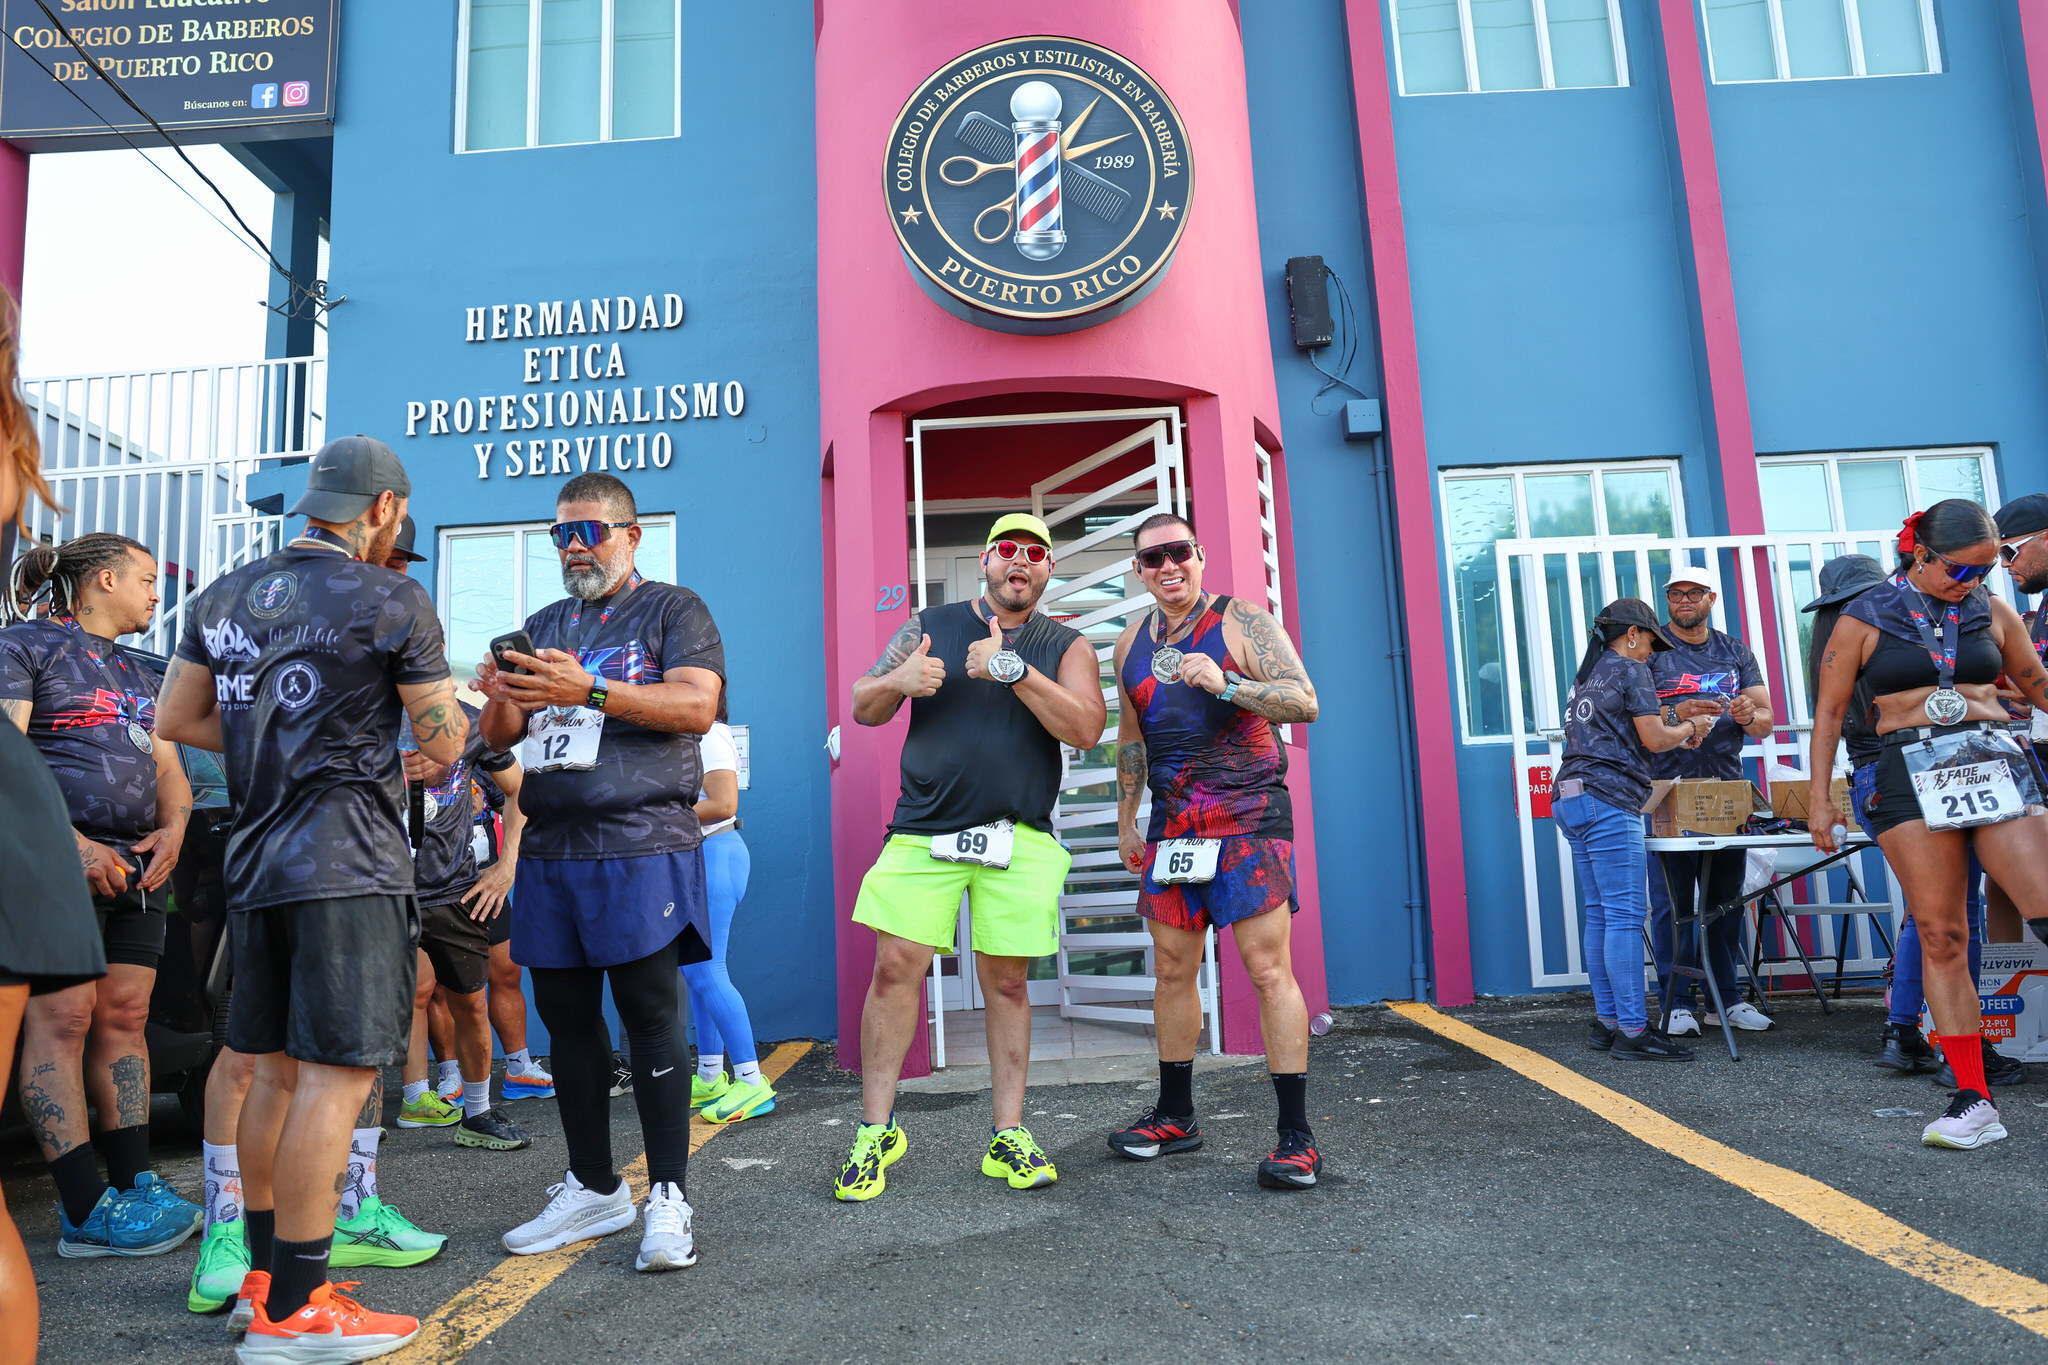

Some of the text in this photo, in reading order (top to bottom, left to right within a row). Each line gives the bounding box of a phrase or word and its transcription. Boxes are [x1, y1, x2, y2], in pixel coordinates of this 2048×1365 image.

[14, 16, 314, 50] COLEGIO DE BARBEROS
[53, 51, 274, 82] DE PUERTO RICO
[184, 98, 248, 110] Búscanos en:
[897, 50, 1181, 192] COLEGIO DE BARBEROS Y ESTILISTAS EN BARBERÍA
[1093, 155, 1135, 170] 1989
[938, 254, 1142, 305] PUERTO RICO
[465, 293, 684, 341] HERMANDAD
[523, 341, 626, 383] ETICA
[405, 380, 745, 436] PROFESIONALISMO
[473, 432, 672, 479] Y SERVICIO
[875, 584, 907, 612] 29
[1676, 673, 1729, 693] 5K
[542, 733, 571, 761] 12
[1947, 765, 1979, 781] FADE
[1965, 773, 1991, 786] RUN
[1941, 789, 2000, 819] 215
[956, 830, 988, 855] 69
[1185, 838, 1207, 846] RUN
[1168, 851, 1194, 874] 65
[1984, 1028, 2012, 1037] PAPER
[1987, 1019, 2009, 1028] 2-PLY
